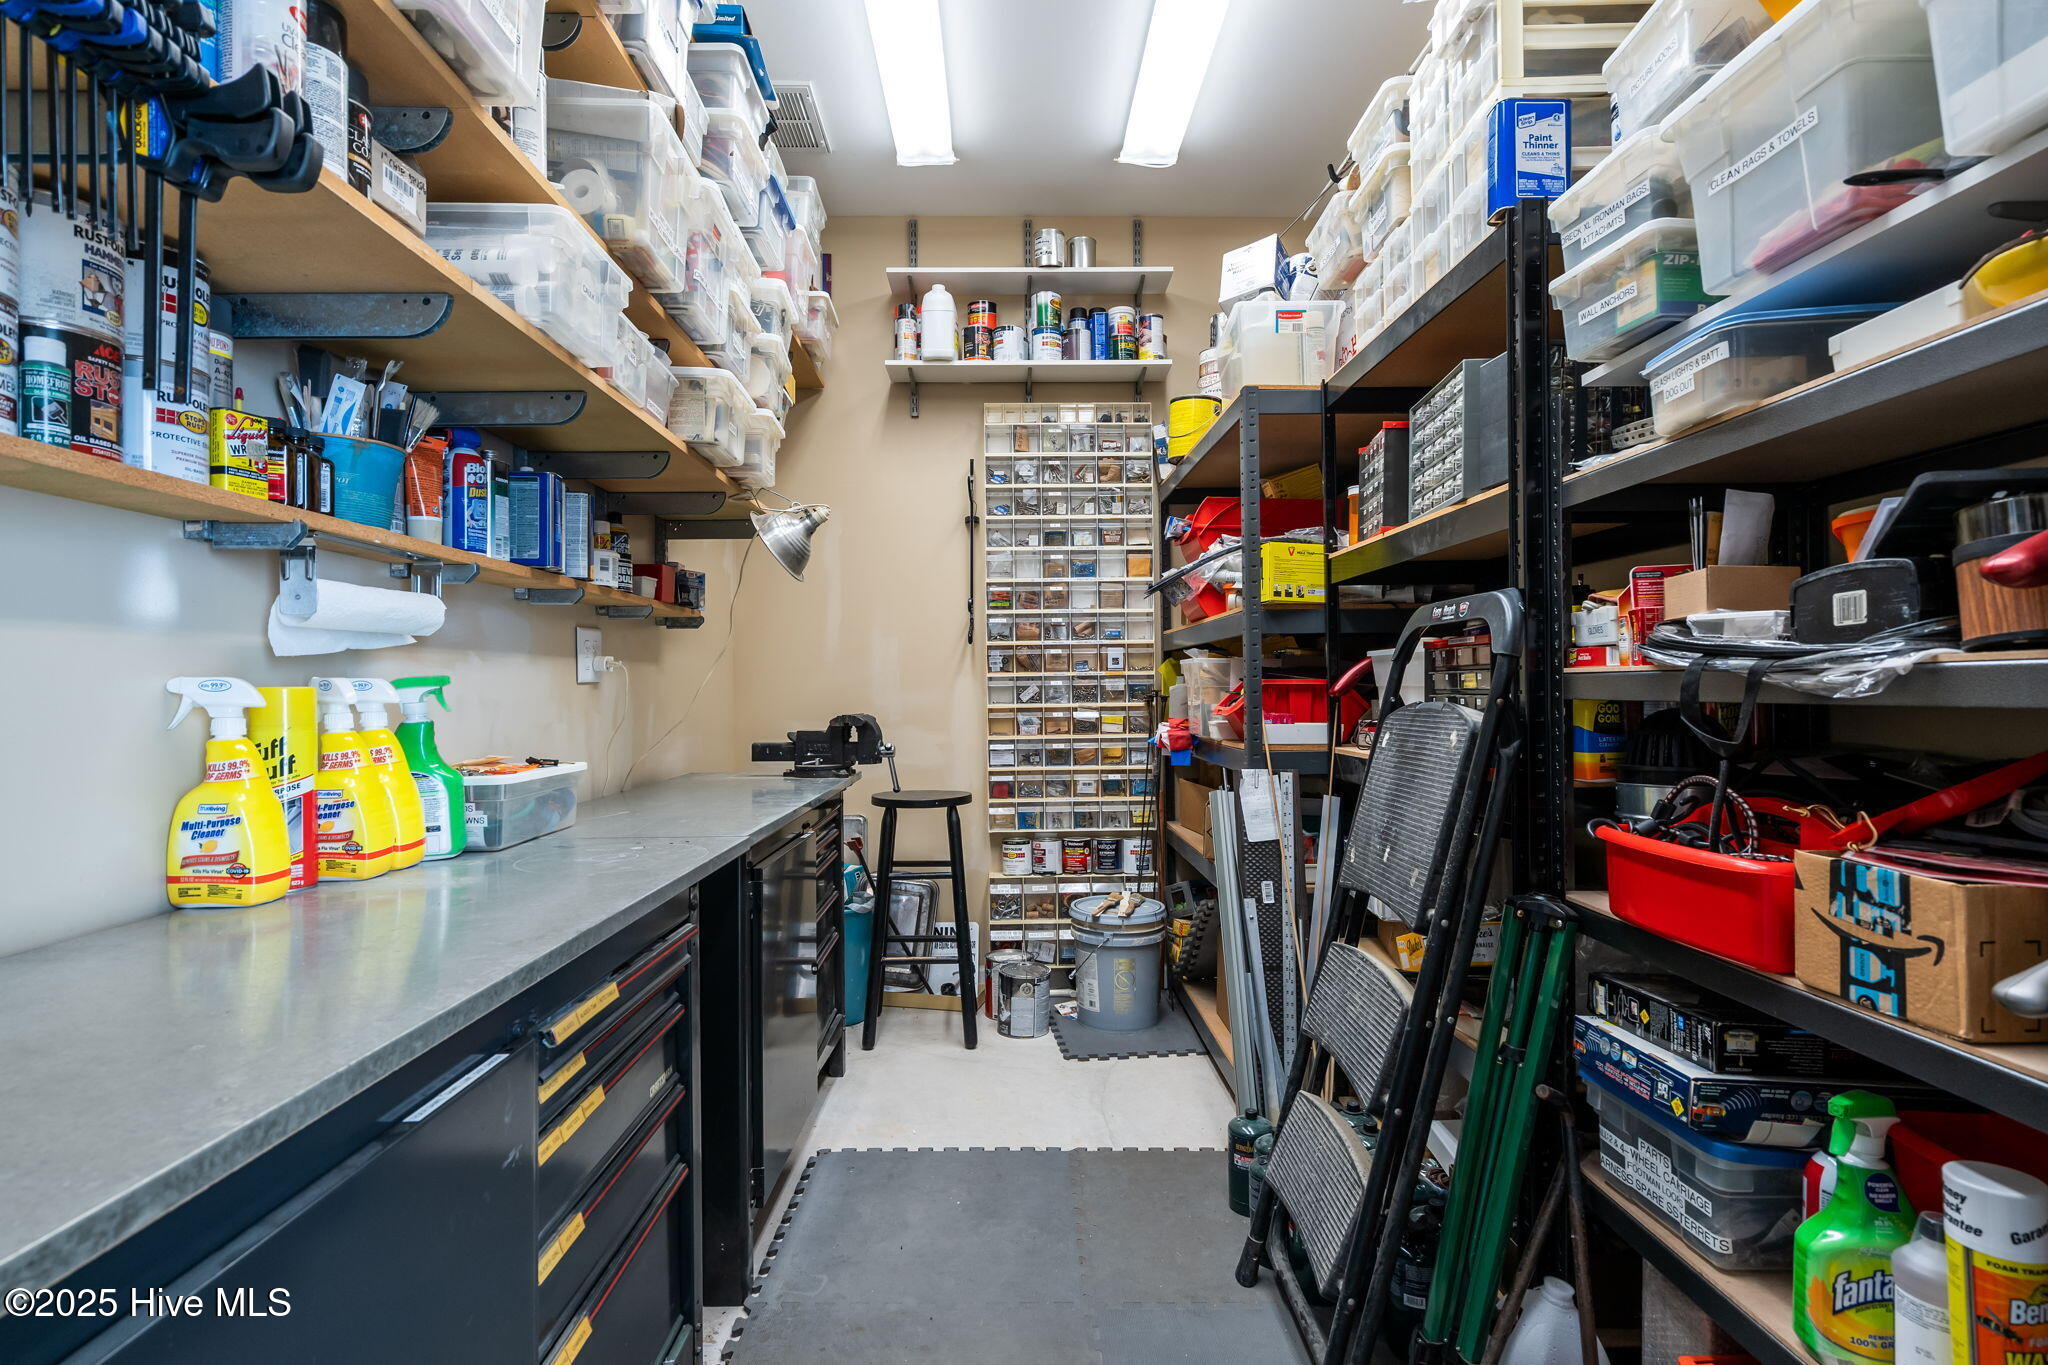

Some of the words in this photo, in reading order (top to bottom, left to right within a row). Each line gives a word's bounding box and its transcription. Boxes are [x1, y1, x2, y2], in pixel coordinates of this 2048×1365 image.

[1629, 64, 1655, 95] PICTURE
[1654, 38, 1678, 69] HOOKS
[1523, 141, 1559, 149] Thinner
[1528, 134, 1553, 142] Paint
[1710, 167, 1742, 192] CLEAN
[1741, 147, 1768, 175] RAGS
[1768, 142, 1776, 153] &
[1776, 111, 1816, 147] TOWELS
[1592, 198, 1626, 226] IRONMAN
[1582, 214, 1624, 247] ATTACHMTS
[1662, 253, 1700, 266] ZIP-
[1579, 304, 1599, 321] WALL
[1599, 285, 1636, 312] ANCHORS
[1664, 386, 1680, 400] DOG
[1679, 379, 1693, 394] OUT
[223, 416, 268, 445] Liquid
[466, 462, 486, 474] Blo
[468, 486, 487, 498] Dus
[1587, 625, 1604, 636] GLOVES
[320, 753, 339, 762] KILLS
[328, 759, 354, 769] GERMS
[207, 763, 227, 773] KILLS
[226, 759, 250, 771] 99.9%
[214, 770, 243, 781] GERMS
[180, 816, 242, 832] Multi-Purpose
[190, 828, 226, 841] Cleaner
[1619, 1143, 1661, 1178] 4-WHEEL
[1639, 1140, 1670, 1169] PARTS
[1600, 1155, 1634, 1186] ARNESS
[1635, 1179, 1664, 1209] SPARE
[1626, 1160, 1661, 1190] FOOTMAN
[1986, 1259, 2019, 1275] FOAM
[1833, 1270, 1895, 1313] fanta
[1850, 1336, 1878, 1349] 100%
